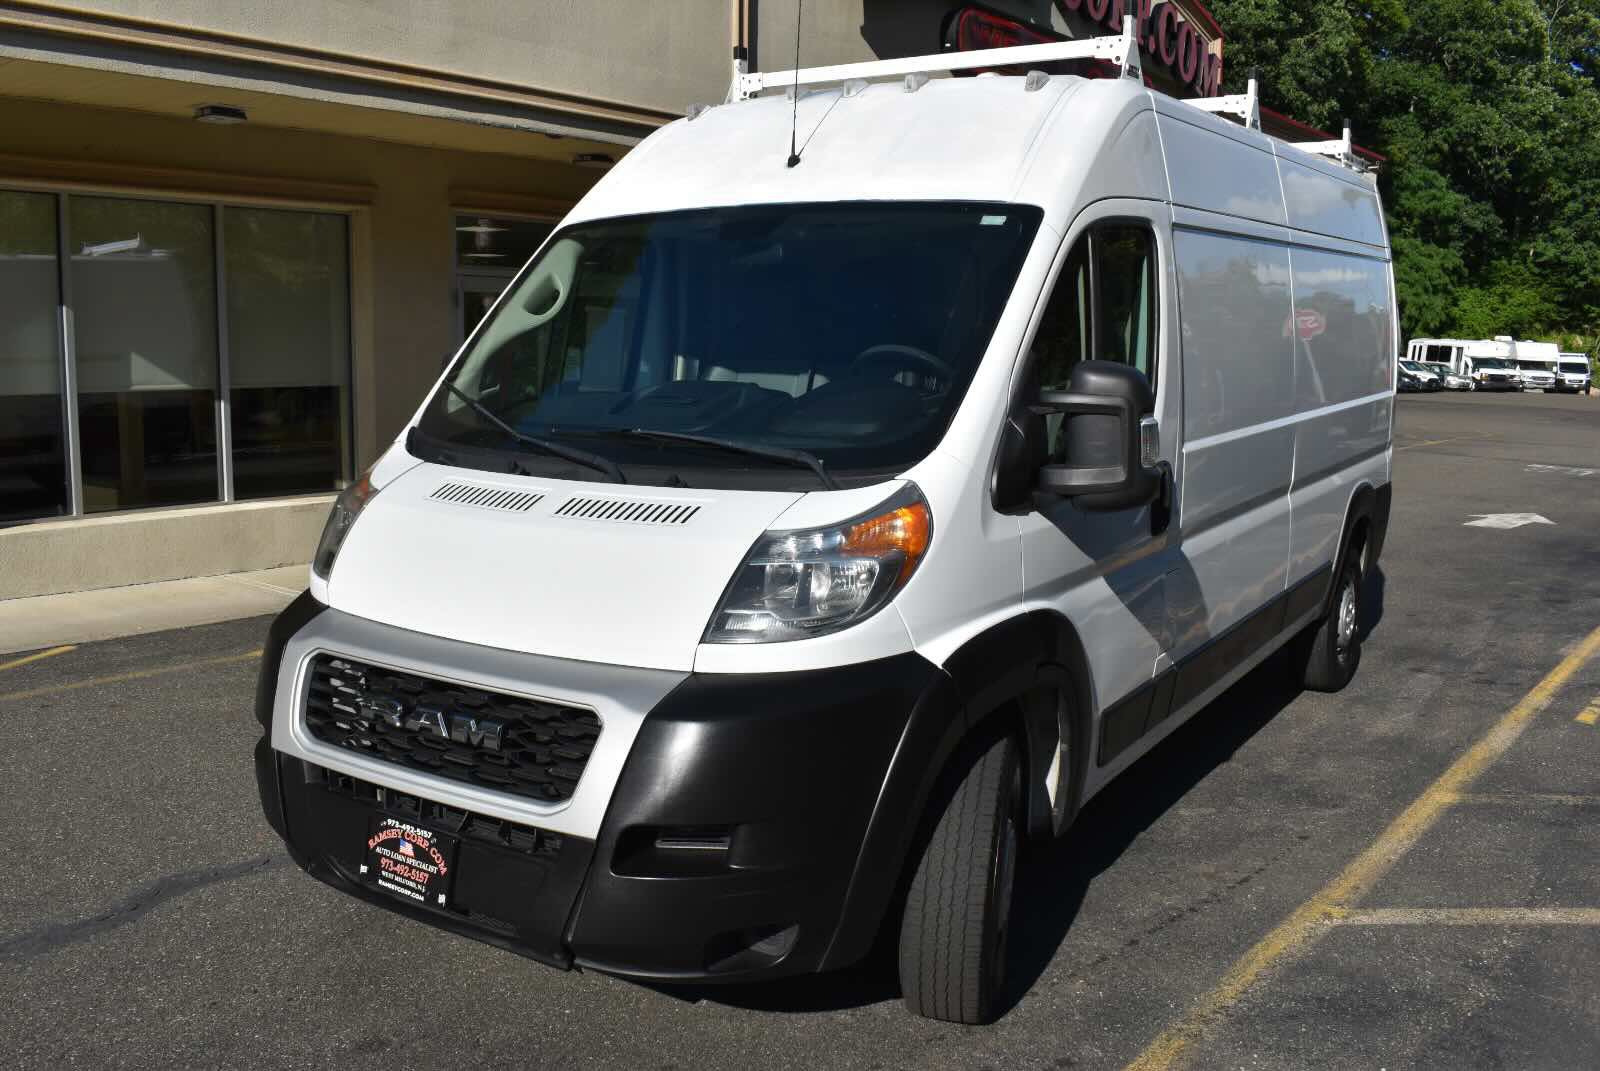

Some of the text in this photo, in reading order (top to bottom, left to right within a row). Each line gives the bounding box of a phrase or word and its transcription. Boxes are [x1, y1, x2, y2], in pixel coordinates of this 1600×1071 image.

[363, 697, 504, 751] RAM
[368, 828, 402, 850] RAMSEY
[387, 818, 432, 839] 973-492-5157
[375, 846, 438, 875] AUTO LOAN SPECIALIST
[380, 857, 430, 884] 973-492-5157
[381, 870, 395, 880] WEST
[378, 879, 425, 902] RAMSEYCORP.COM
